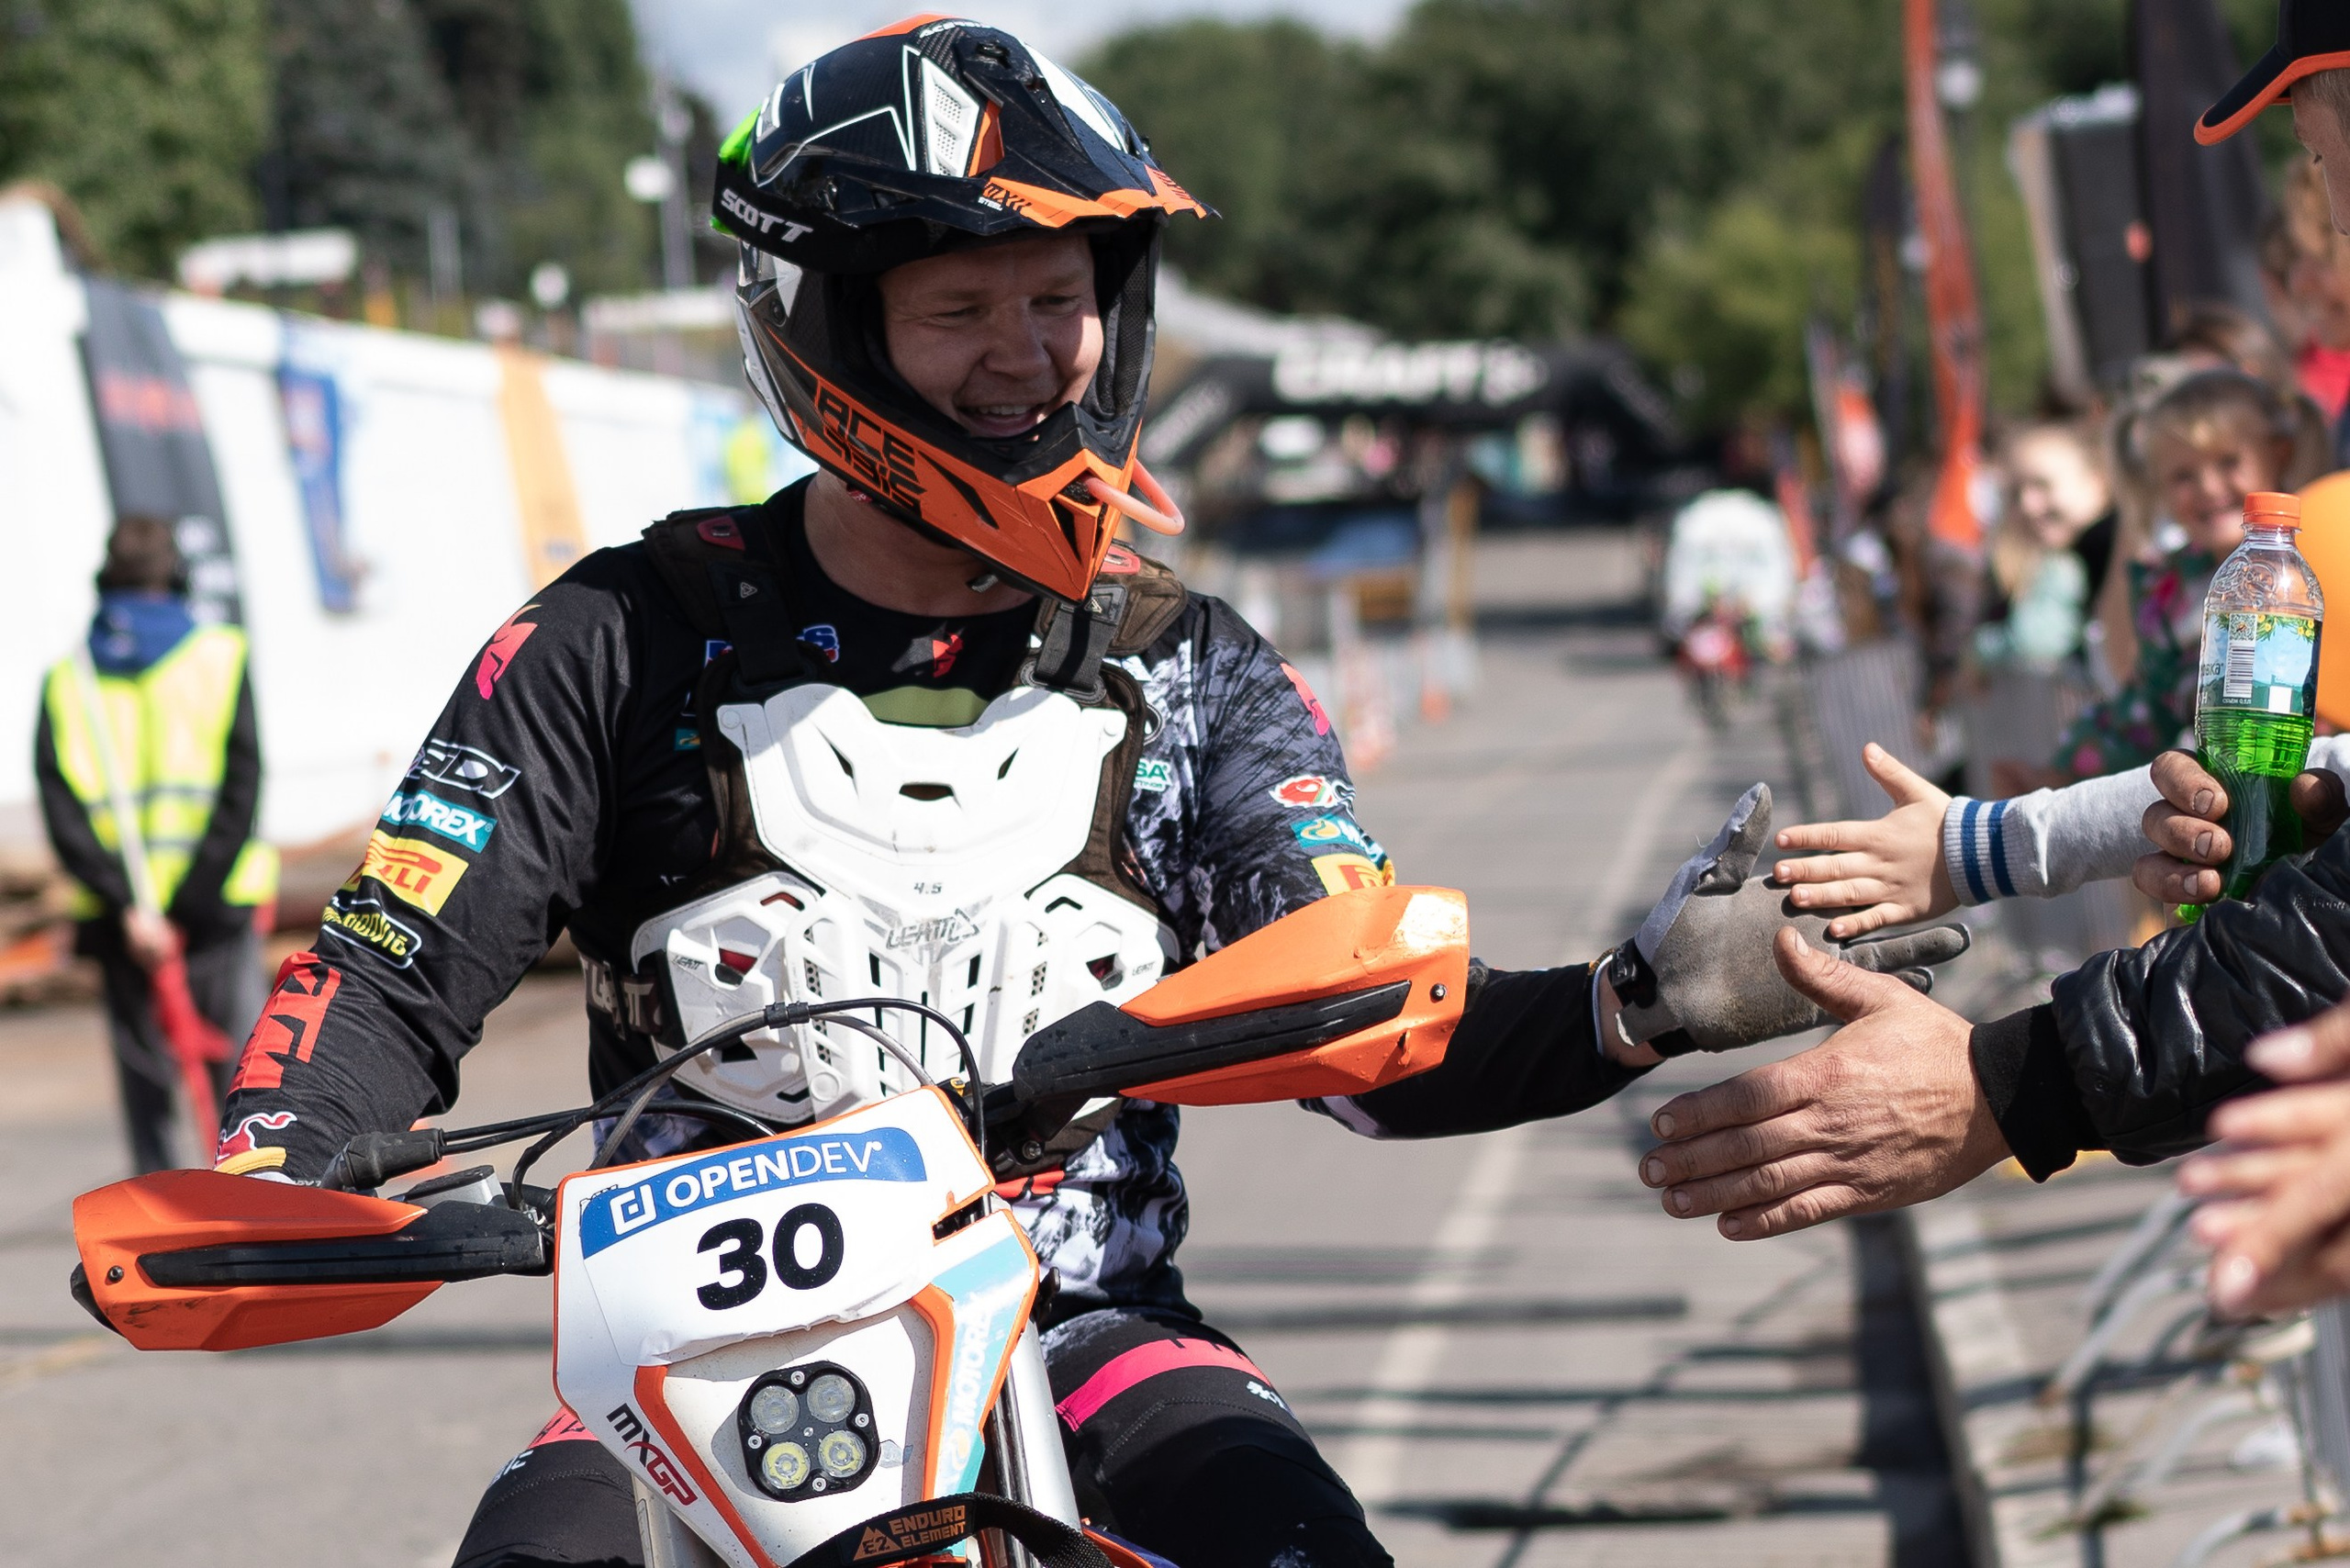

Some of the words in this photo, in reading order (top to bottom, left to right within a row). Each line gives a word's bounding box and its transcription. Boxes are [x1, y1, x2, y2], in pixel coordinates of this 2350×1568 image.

[721, 187, 814, 242] SCOTT
[817, 385, 920, 483] ACE
[913, 882, 943, 895] 4.5
[665, 1141, 878, 1208] OPENDEV
[696, 1203, 844, 1310] 30
[606, 1402, 699, 1506] MXGP
[888, 1505, 966, 1535] ENDURO
[901, 1521, 967, 1548] ELEMENT
